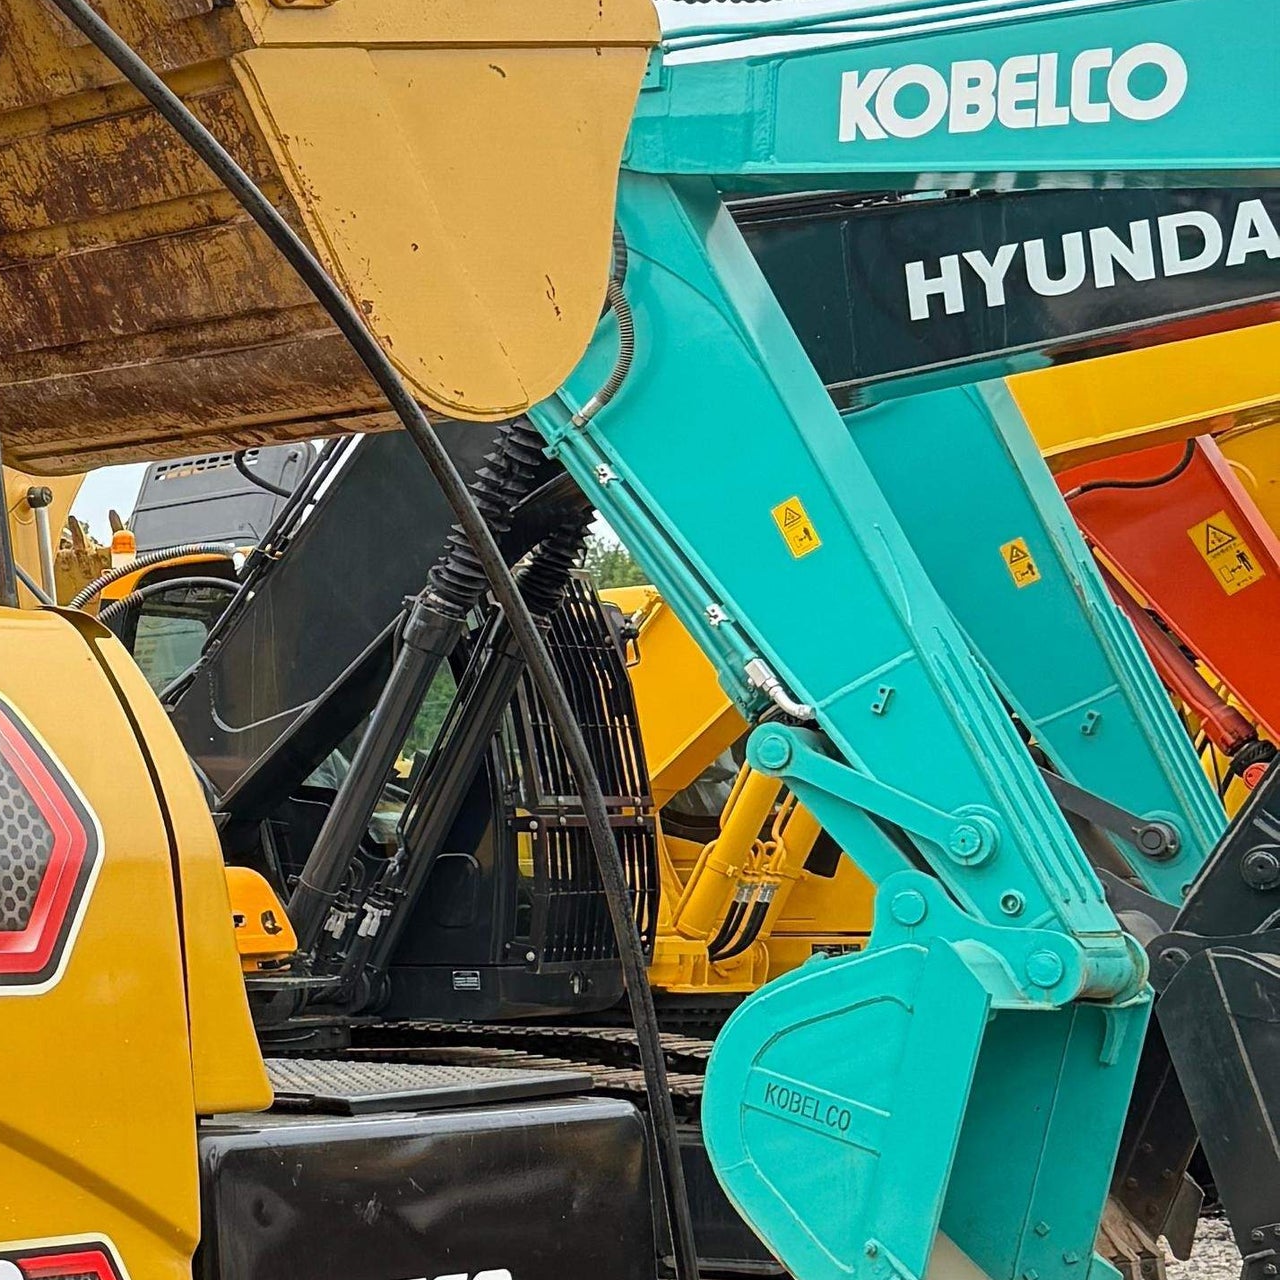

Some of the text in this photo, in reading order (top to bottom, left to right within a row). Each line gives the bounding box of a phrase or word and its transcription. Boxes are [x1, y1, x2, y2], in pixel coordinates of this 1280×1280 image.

[838, 42, 1188, 143] KOBELCO
[904, 198, 1280, 321] HYUNDA
[764, 1081, 852, 1132] KOBELCO
